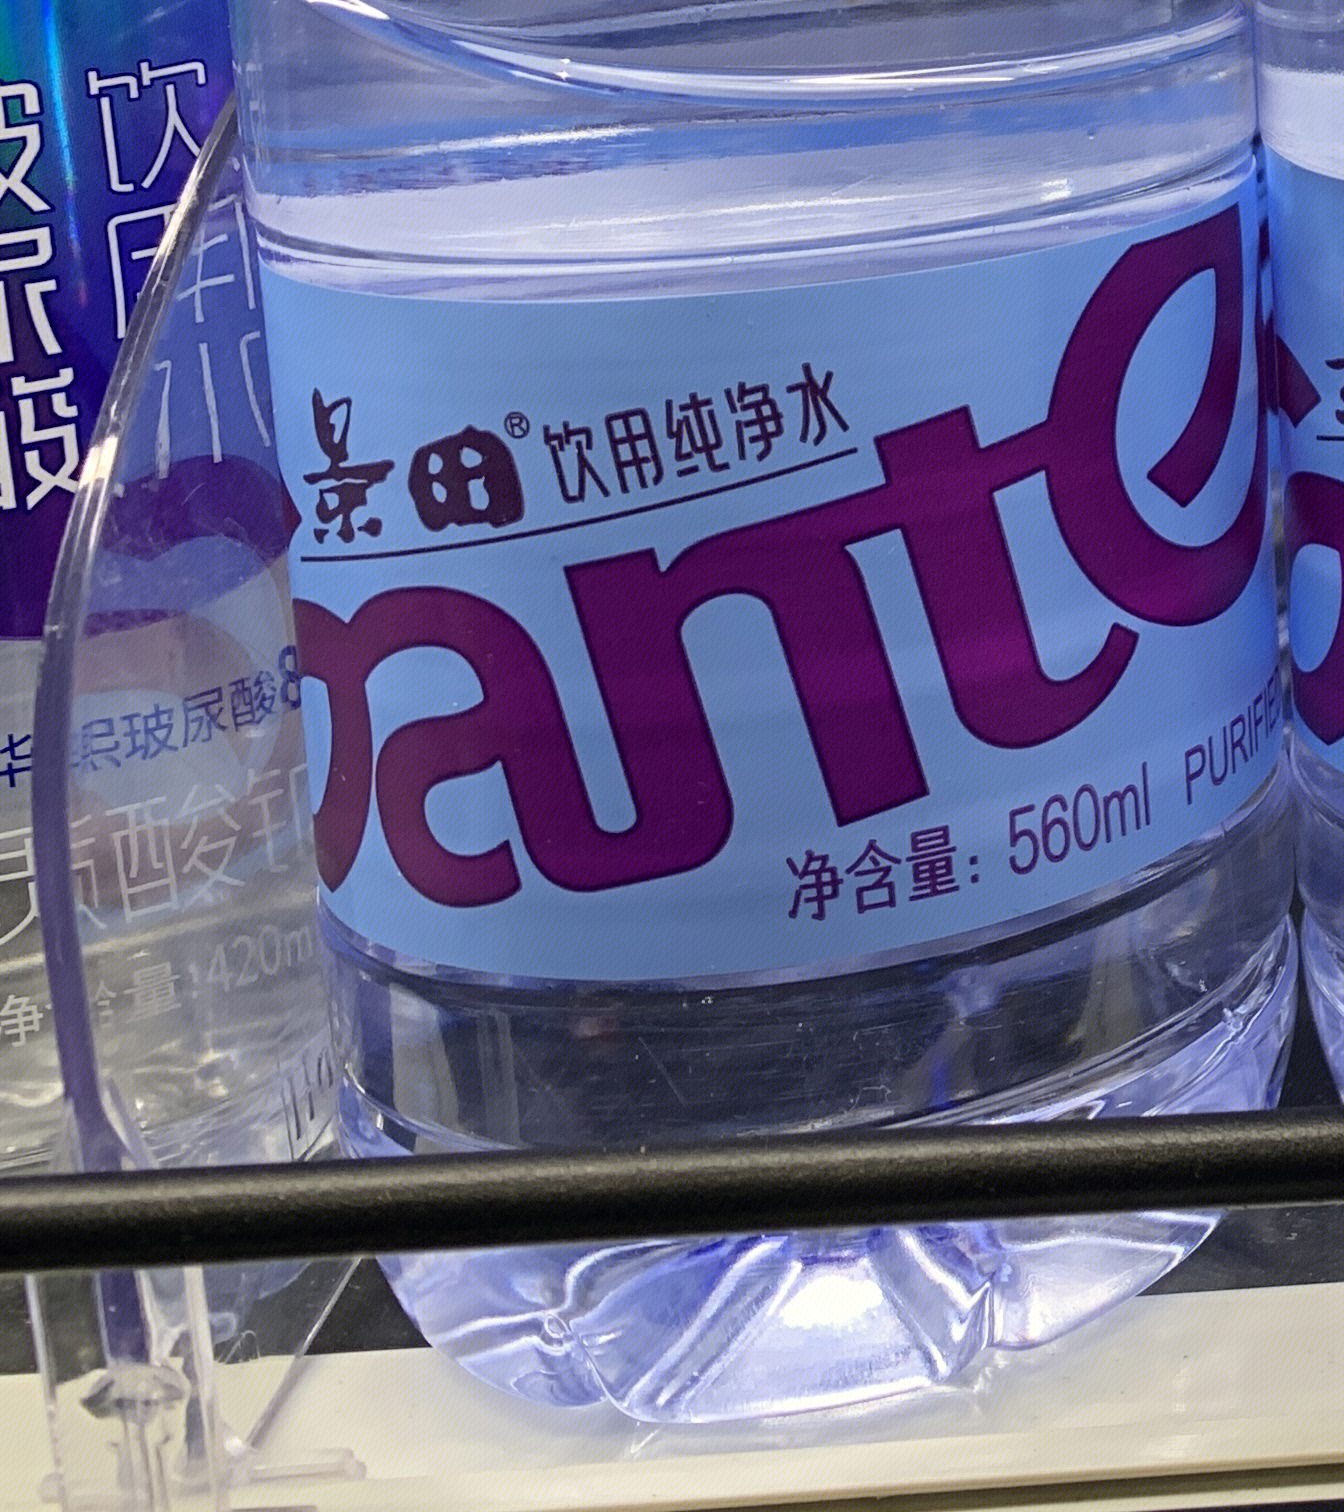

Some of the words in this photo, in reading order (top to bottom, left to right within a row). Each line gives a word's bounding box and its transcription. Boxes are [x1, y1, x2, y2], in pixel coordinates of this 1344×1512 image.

[544, 362, 850, 504] 饮用纯净水
[786, 825, 979, 922] 净含量：
[1008, 761, 1151, 876] 560ml
